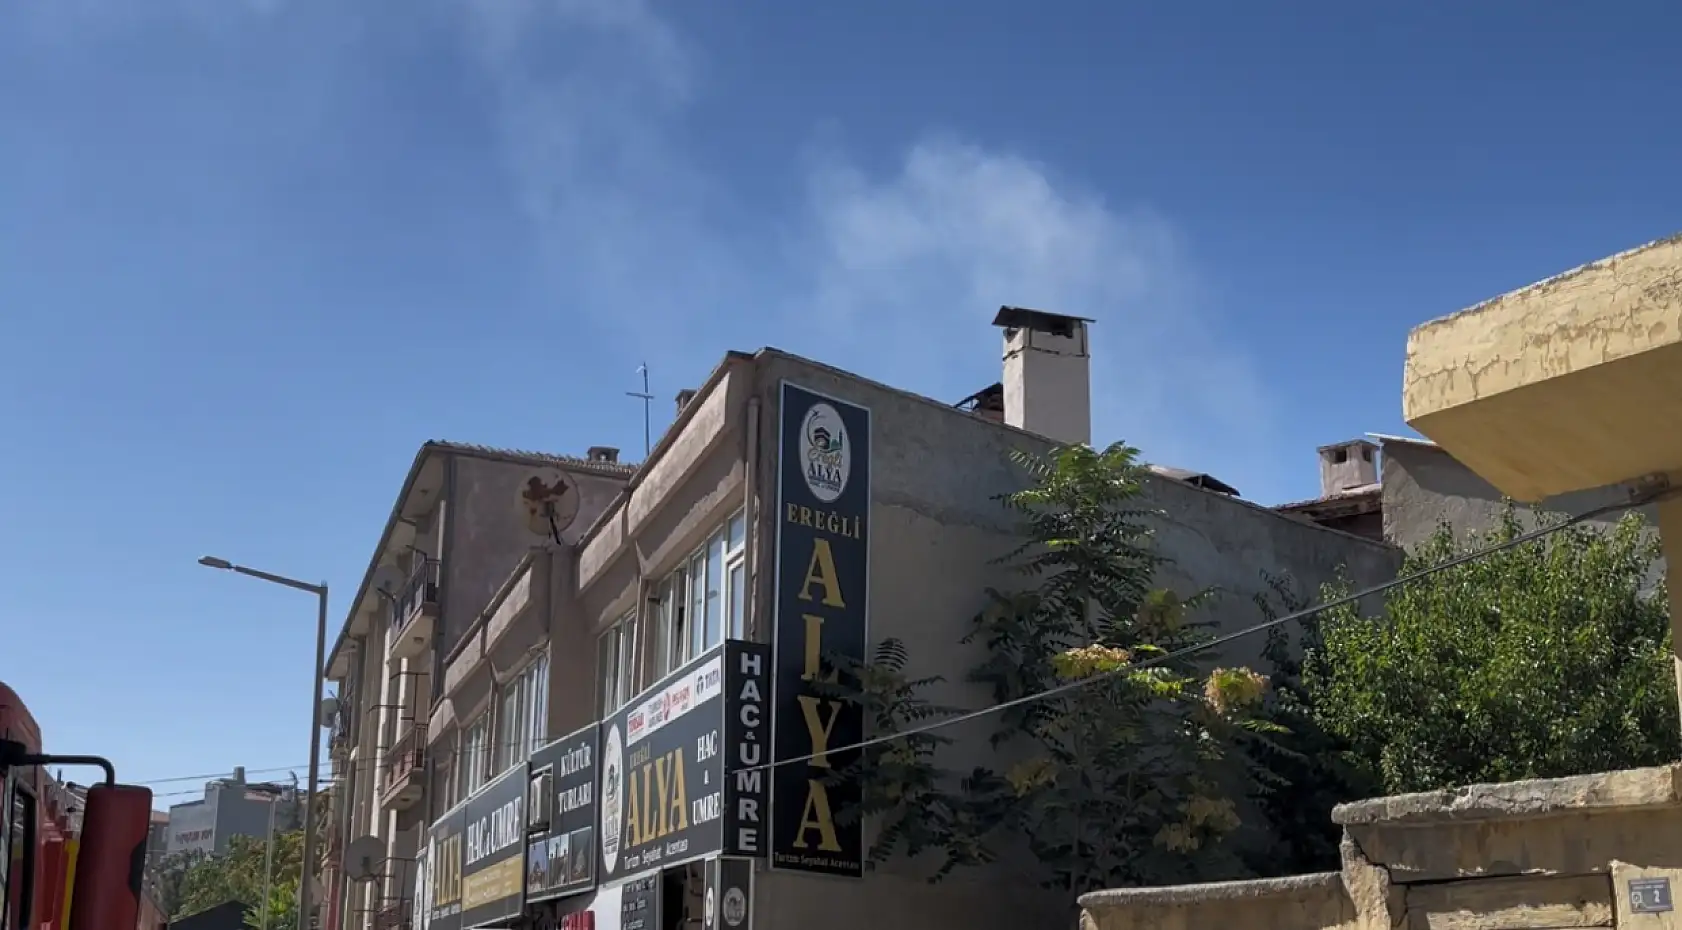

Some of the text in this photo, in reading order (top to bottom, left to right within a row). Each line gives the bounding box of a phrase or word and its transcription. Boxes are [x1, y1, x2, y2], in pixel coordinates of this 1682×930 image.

[807, 462, 842, 483] ALYA
[786, 502, 861, 540] EREĞLİ
[739, 651, 762, 728] HAC
[792, 537, 846, 852] ALYA
[560, 742, 592, 778] KÜLTÜR
[697, 729, 718, 763] HAC
[624, 747, 688, 850] ALYA
[692, 792, 720, 825] UMRE
[735, 742, 762, 852] UMRE
[1653, 888, 1661, 903] 2
